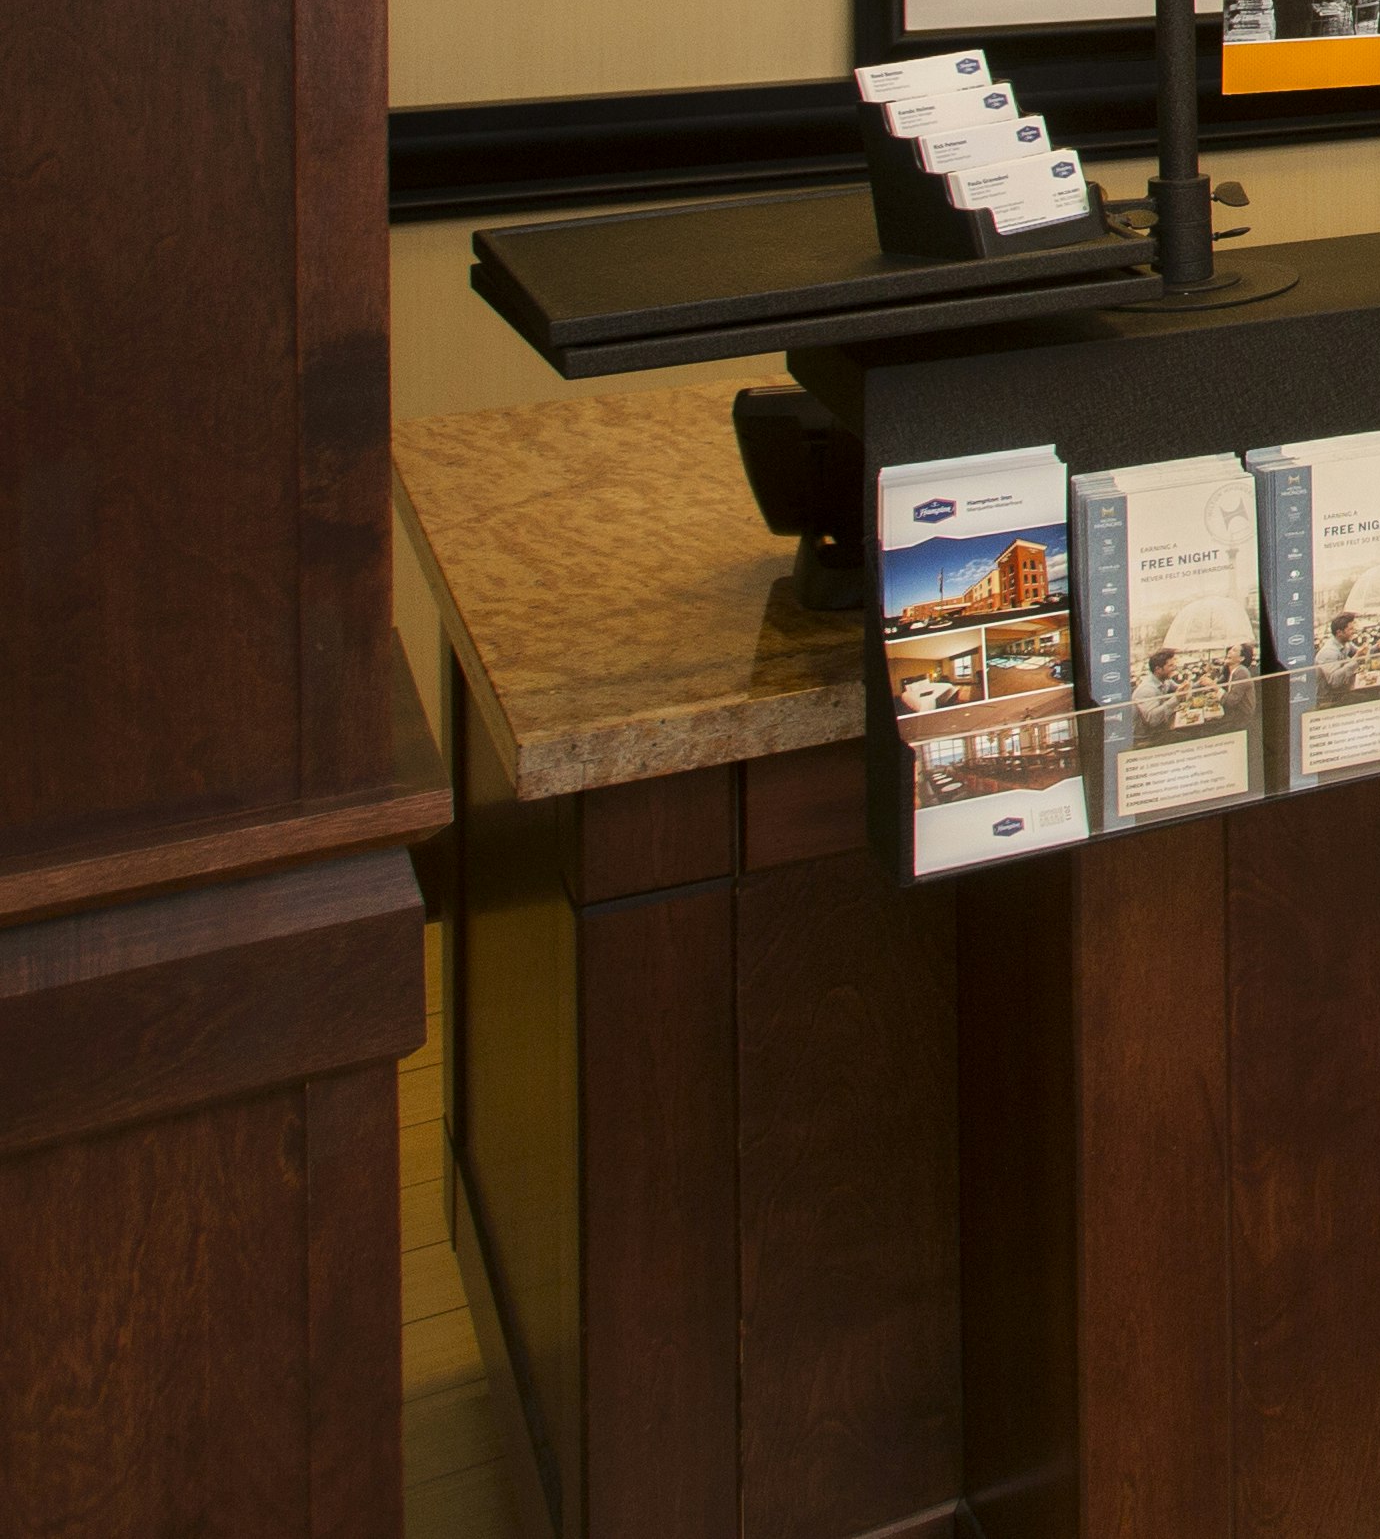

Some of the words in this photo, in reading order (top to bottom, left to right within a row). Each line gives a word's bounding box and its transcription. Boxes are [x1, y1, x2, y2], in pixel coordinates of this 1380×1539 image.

[916, 506, 953, 519] Hampton
[1324, 524, 1354, 537] FREE
[1140, 544, 1171, 554] EARNING
[1323, 540, 1345, 549] NEVER
[1346, 538, 1360, 548] FELT
[1141, 557, 1174, 571] FREE
[1178, 549, 1220, 565] NIGHT
[1140, 574, 1164, 583] NEVER
[1165, 572, 1180, 580] FELT
[1181, 570, 1191, 578] SO
